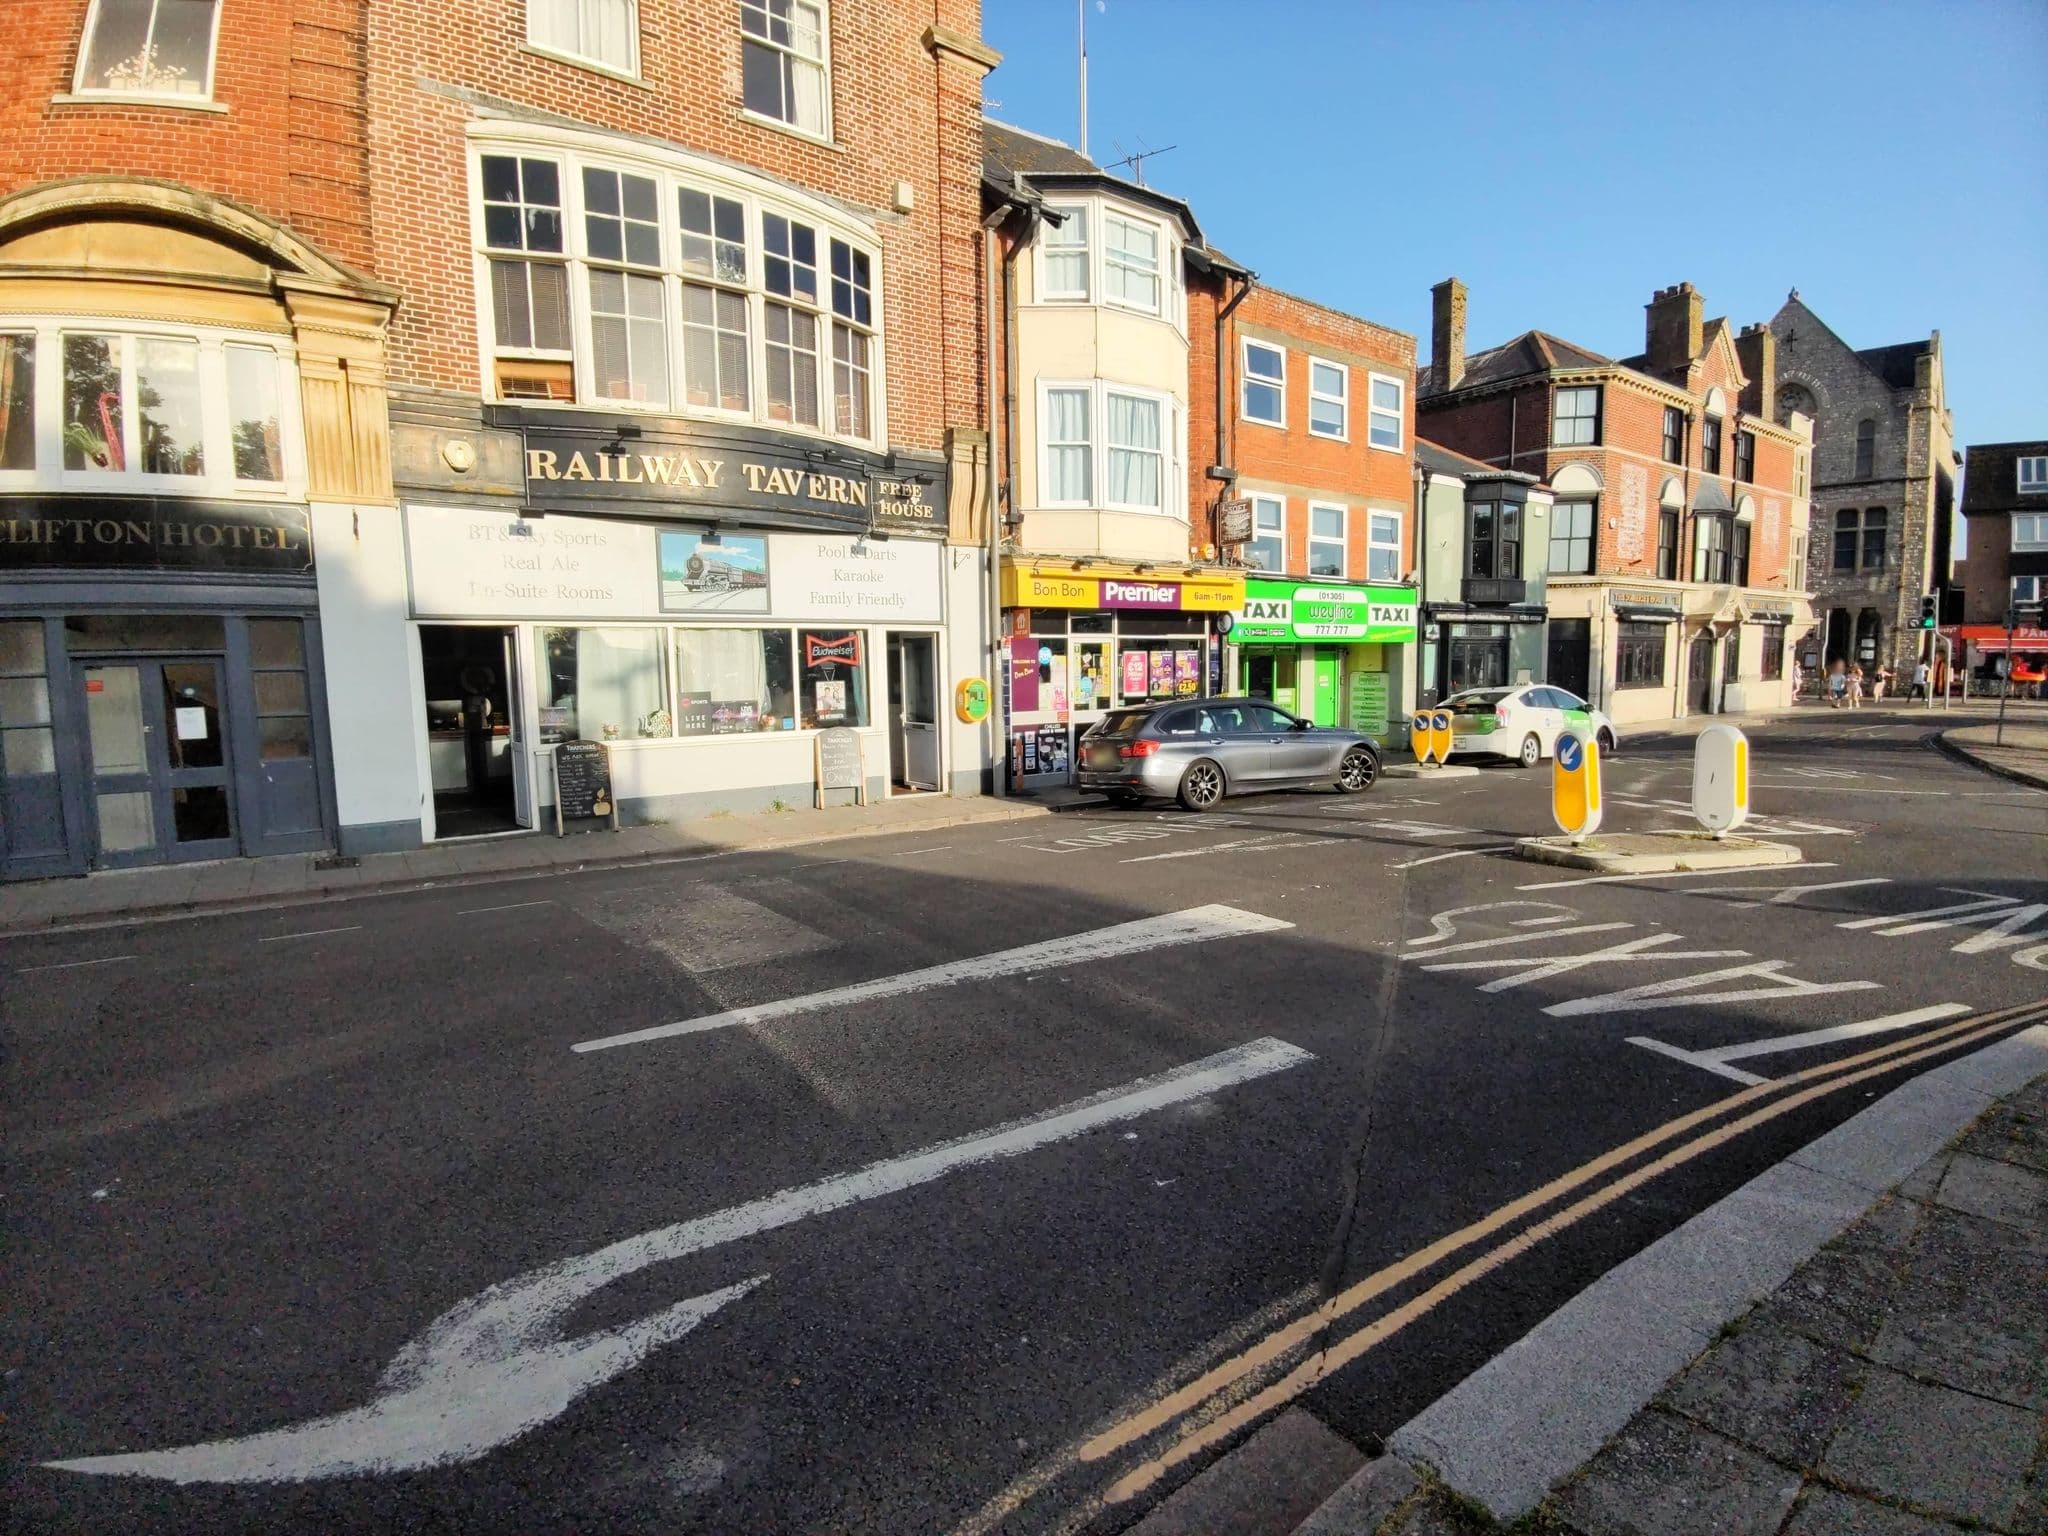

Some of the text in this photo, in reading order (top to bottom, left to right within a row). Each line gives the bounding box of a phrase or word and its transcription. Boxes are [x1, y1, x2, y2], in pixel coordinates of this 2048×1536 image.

[526, 449, 867, 507] RAILWAY TAVERN
[879, 481, 922, 498] FREE
[879, 501, 934, 519] HOUSE
[161, 522, 299, 550] HOTEL
[469, 525, 496, 541] BT
[516, 527, 546, 547] Sky
[553, 528, 607, 548] Sports
[817, 544, 897, 561] Pool & Darts
[503, 554, 580, 572] Real Ale
[834, 569, 885, 582] Karaoke
[556, 584, 614, 600] Rooms
[1033, 582, 1085, 597] Bon Bon
[1105, 581, 1177, 603] Premier
[1319, 591, 1345, 601] (01305)
[810, 591, 907, 608] Family Friendly
[1242, 602, 1287, 618] TAXI
[1309, 602, 1353, 622] weyline
[1371, 607, 1409, 622] TAXI
[1315, 625, 1349, 635] 777 777
[812, 646, 855, 657] Budweiser
[685, 714, 706, 722] LIVE
[1019, 818, 1252, 854] LOADING
[1397, 900, 1973, 1086] TAXIS
